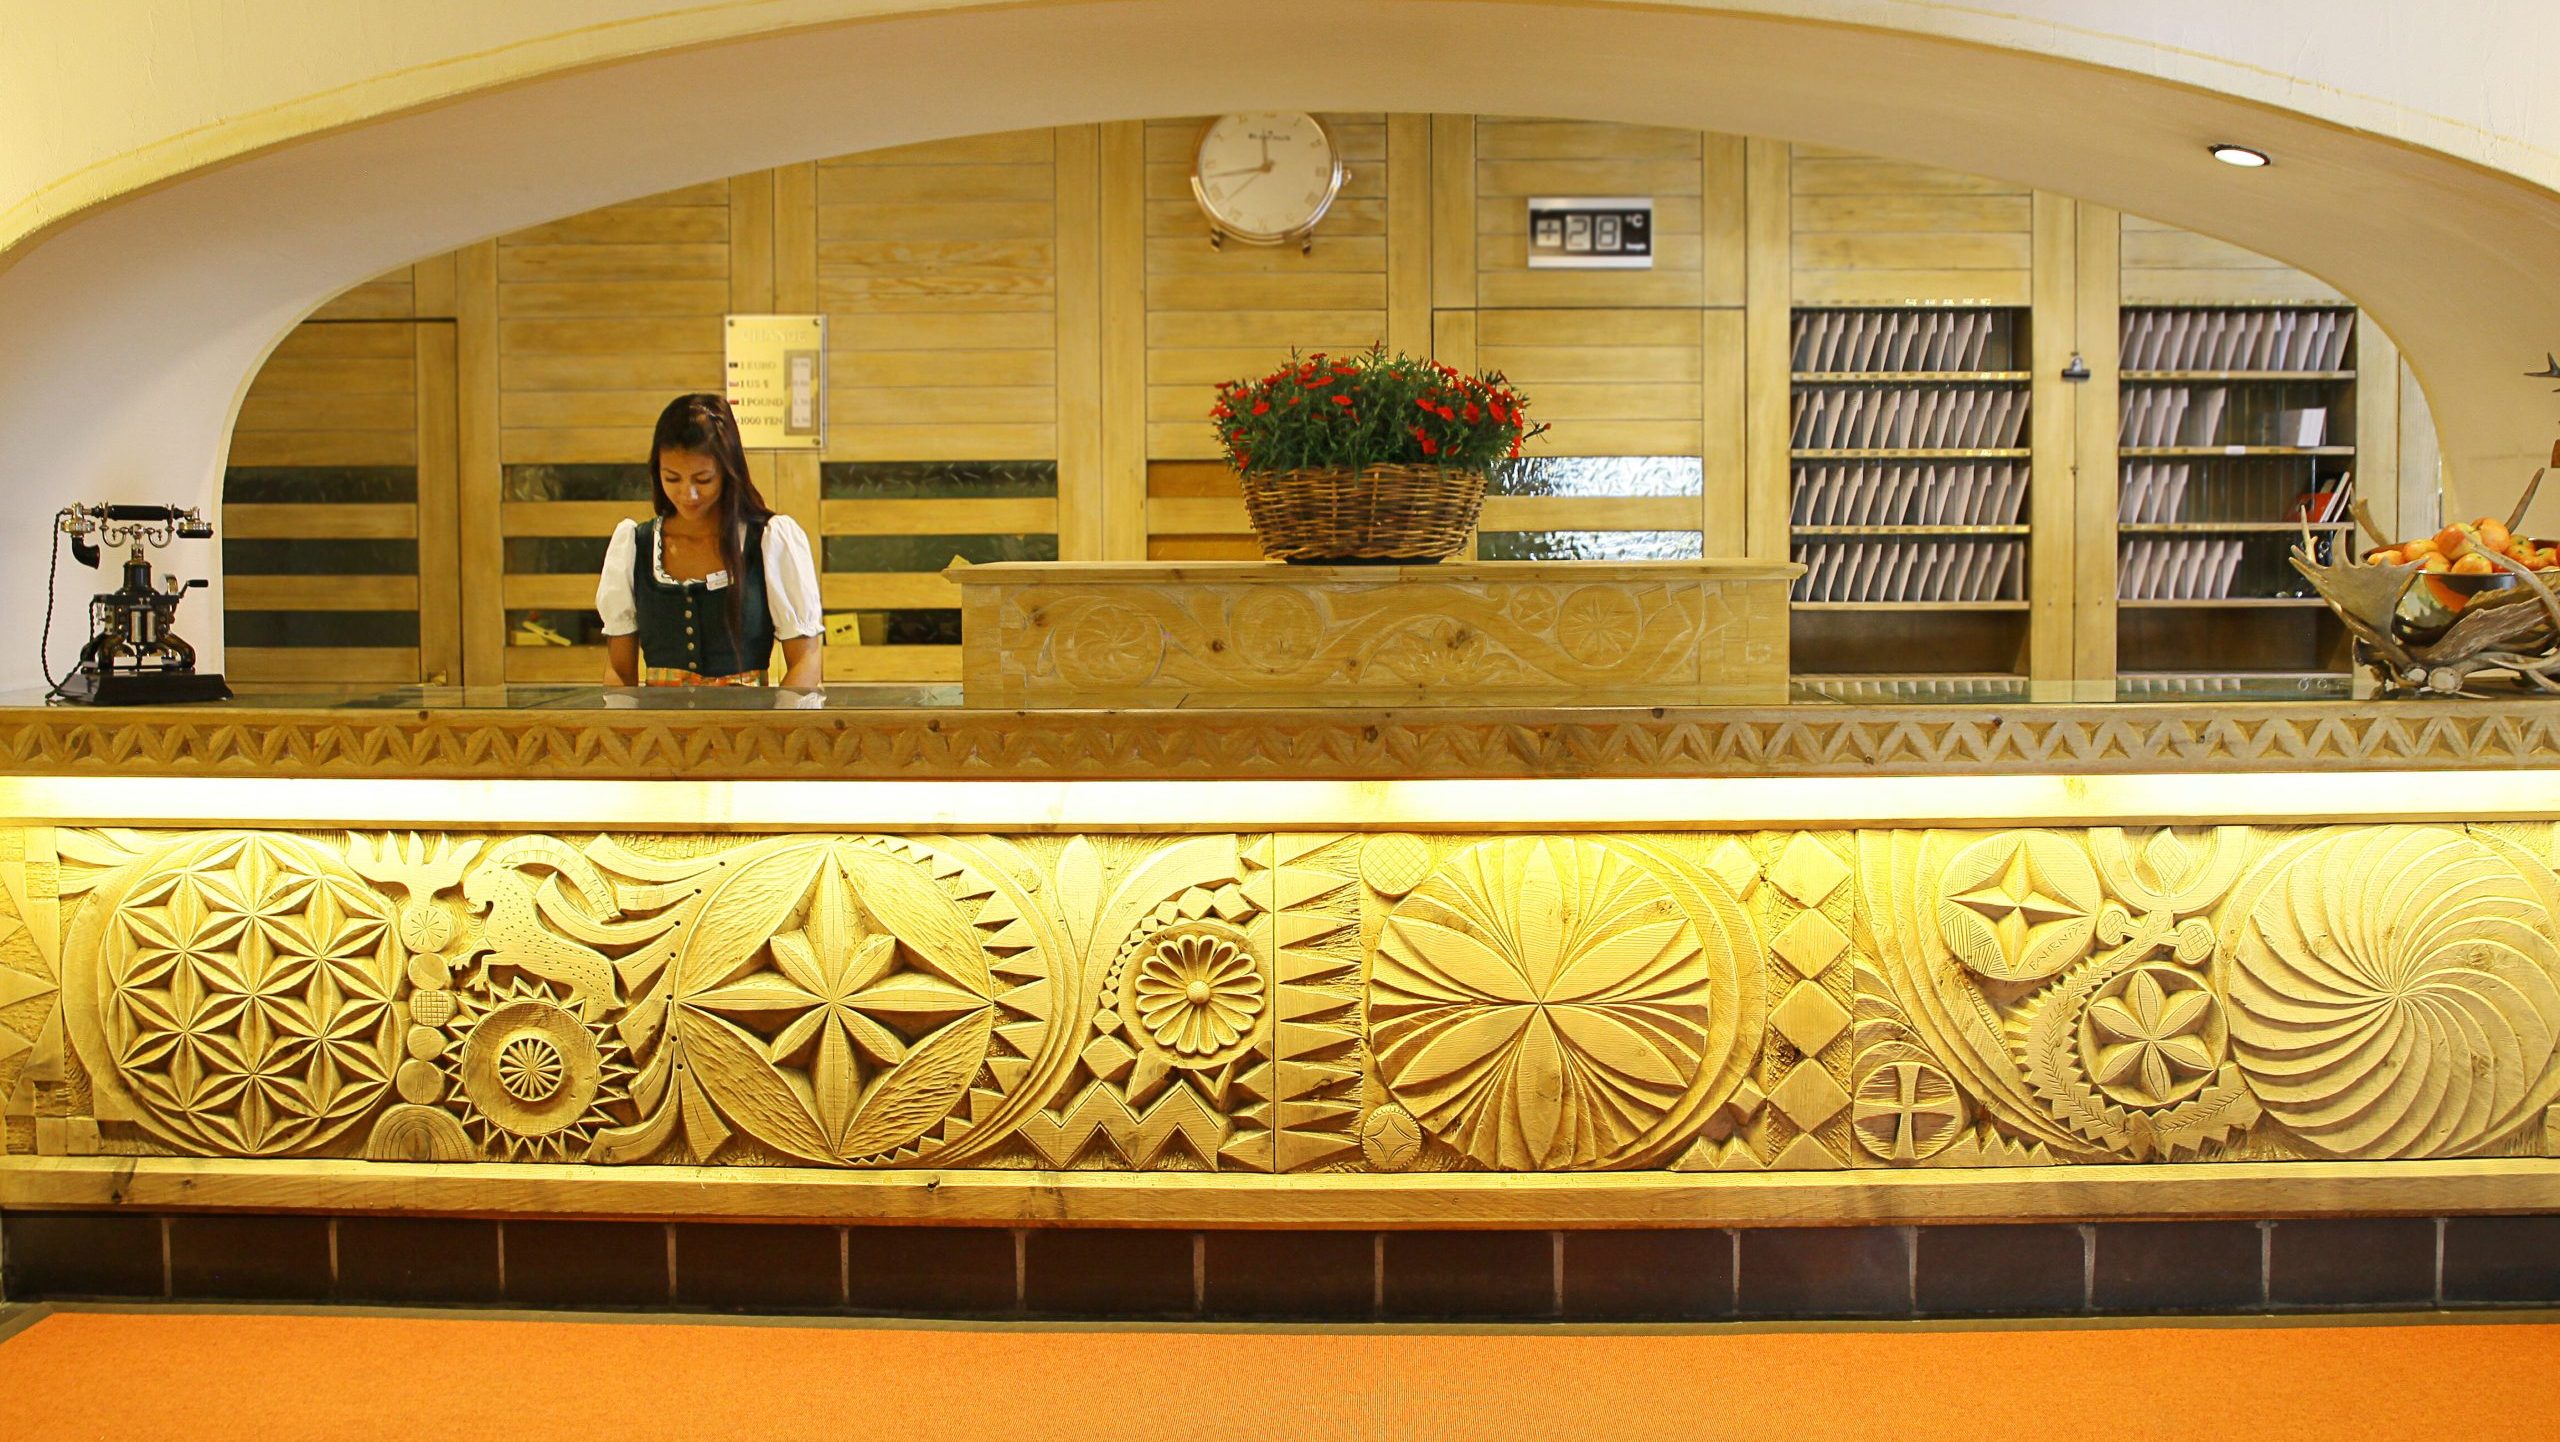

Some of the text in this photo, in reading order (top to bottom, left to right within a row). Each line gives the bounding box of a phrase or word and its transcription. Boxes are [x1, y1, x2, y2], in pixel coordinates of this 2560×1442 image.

[747, 361, 777, 370] EURO
[747, 397, 784, 407] POUND
[740, 416, 762, 425] 1000
